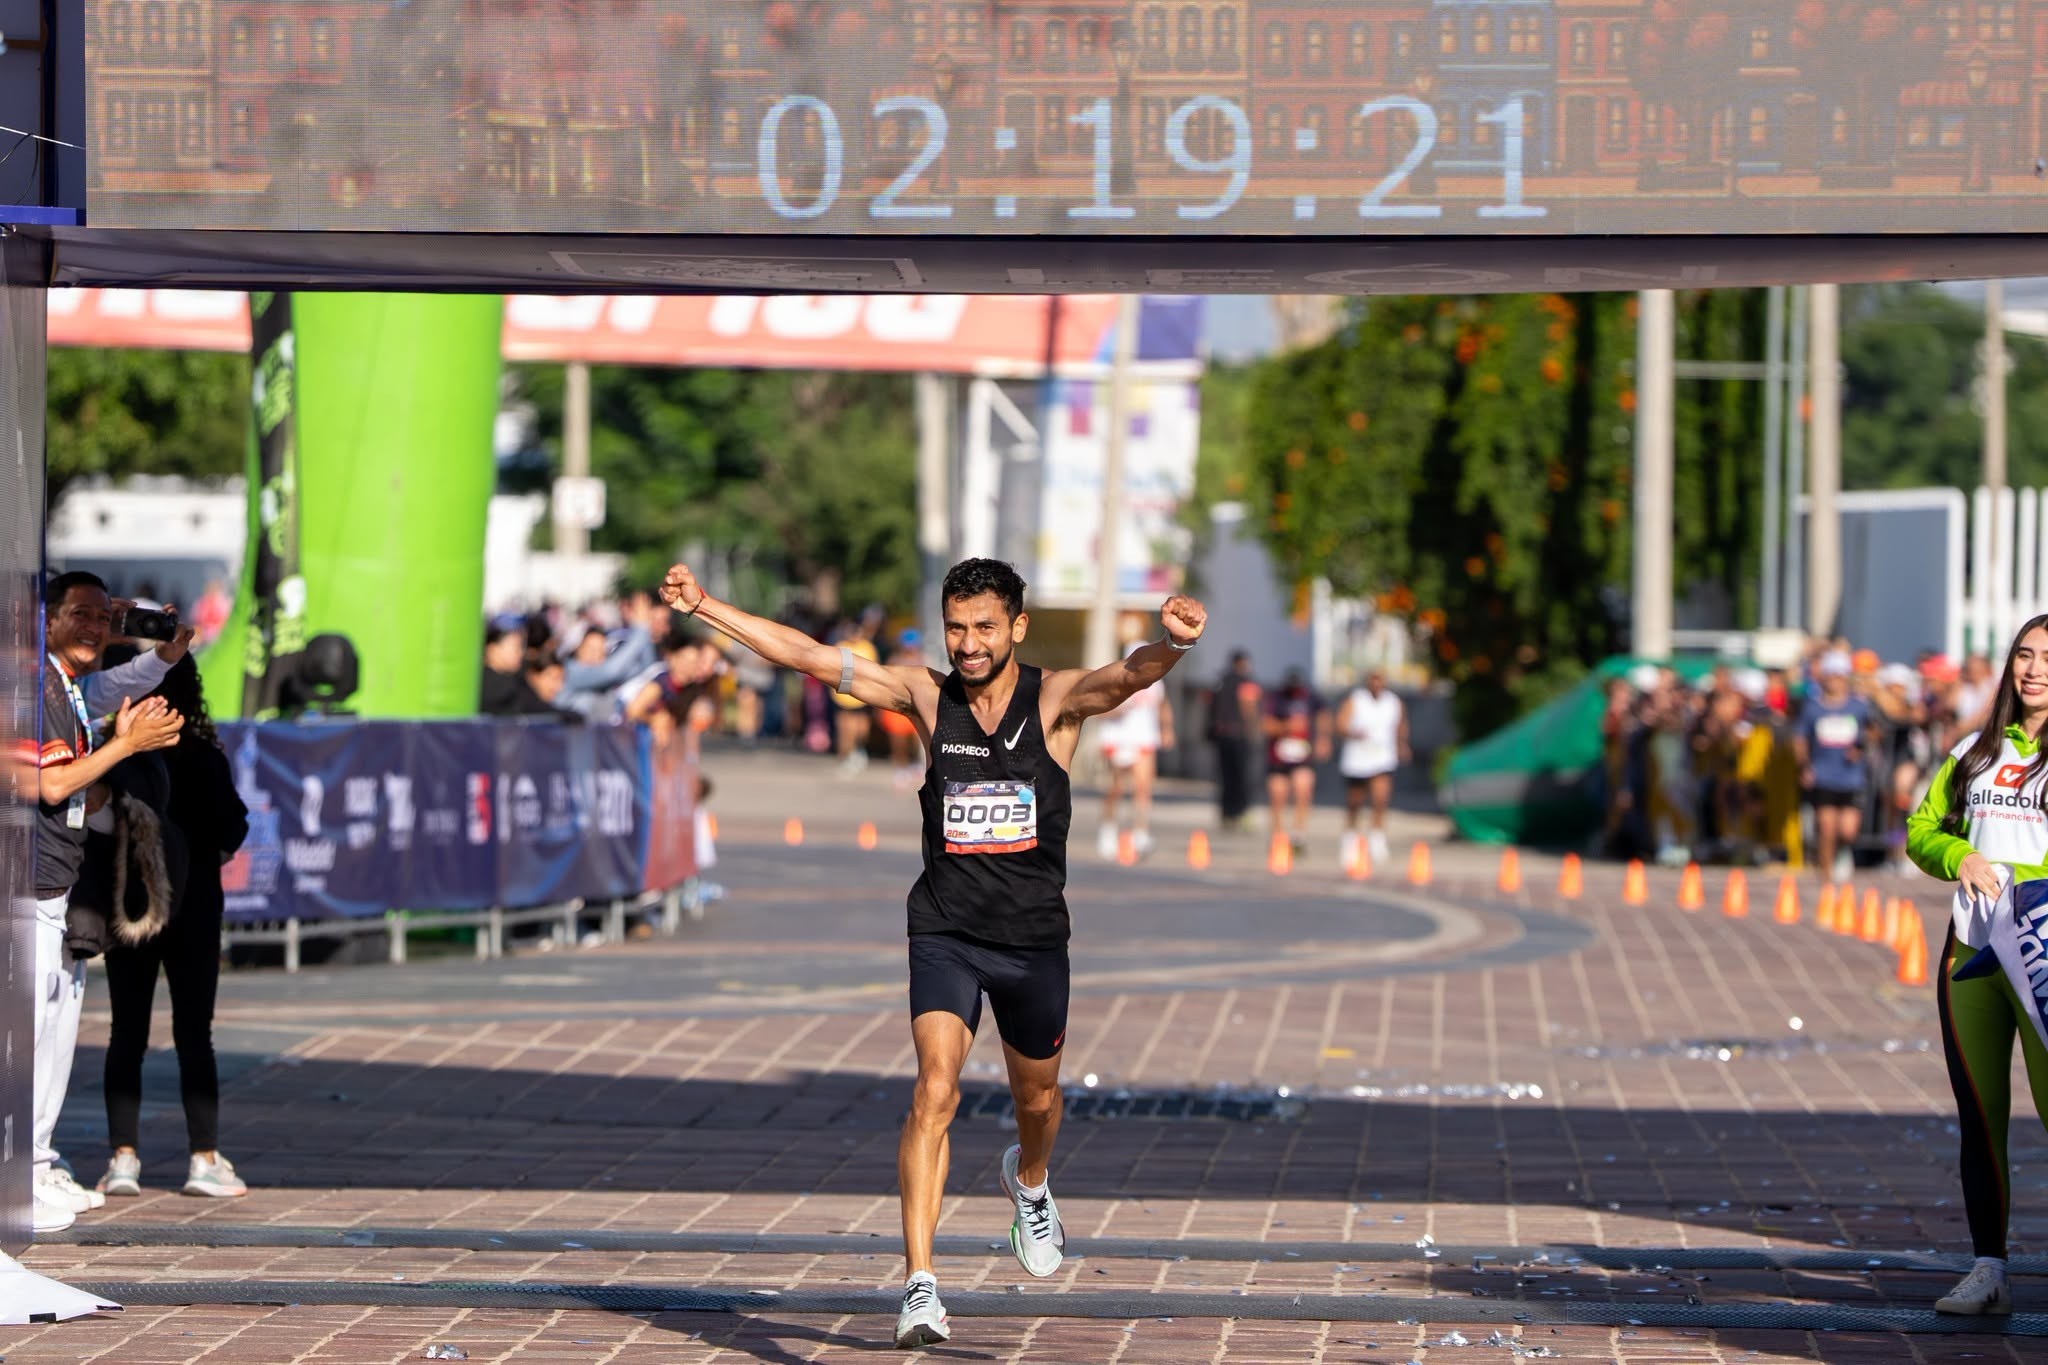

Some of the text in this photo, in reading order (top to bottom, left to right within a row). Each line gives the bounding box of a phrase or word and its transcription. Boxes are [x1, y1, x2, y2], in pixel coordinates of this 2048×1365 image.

[756, 93, 1549, 221] 02:19:21
[942, 744, 990, 757] PACHECO
[947, 803, 1032, 824] 0003
[1990, 810, 2043, 823] Financiera
